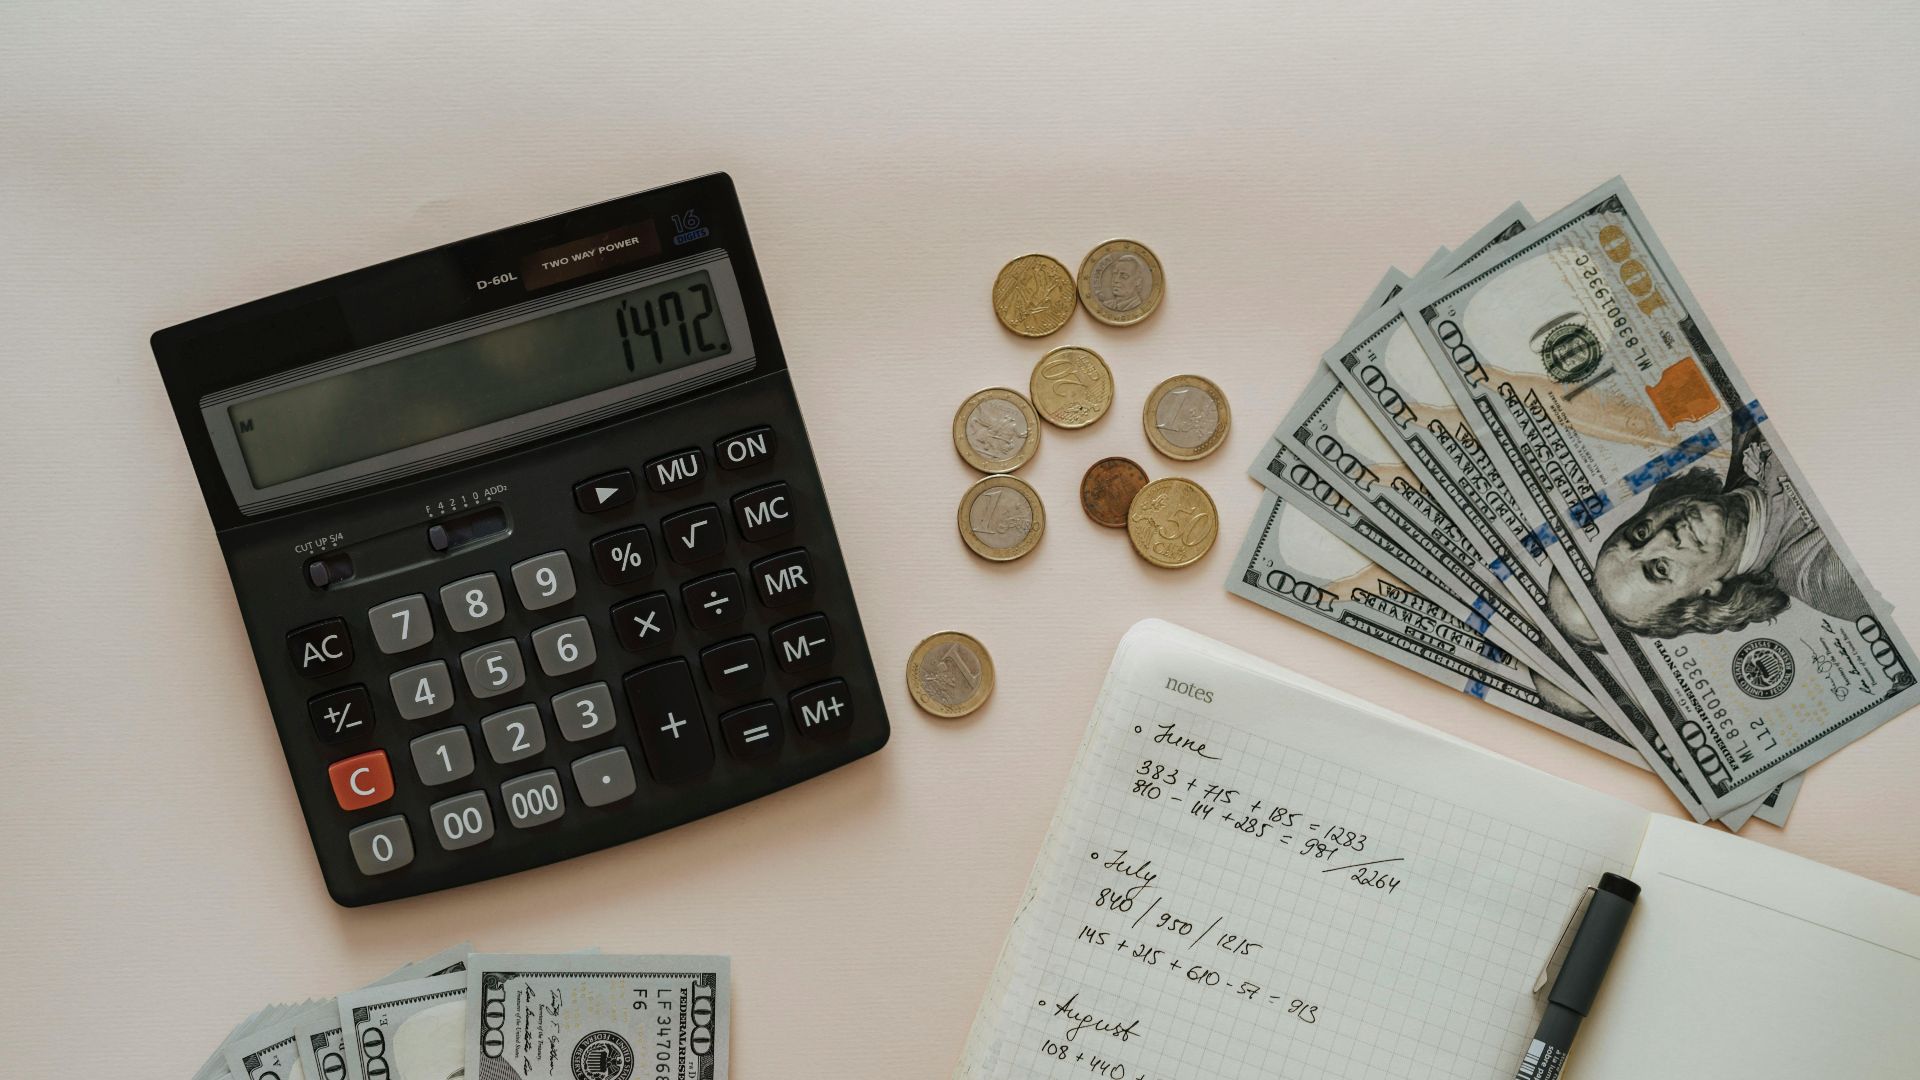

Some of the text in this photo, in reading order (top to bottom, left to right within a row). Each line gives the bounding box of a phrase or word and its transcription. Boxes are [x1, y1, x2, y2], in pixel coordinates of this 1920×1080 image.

[671, 209, 701, 234] 16
[676, 228, 707, 244] DIGITS
[541, 236, 640, 271] TWO WAY POWER
[1595, 222, 1667, 317] 100
[476, 271, 518, 291] D-60L
[1573, 252, 1653, 372] ML 83801932 C
[1435, 318, 1488, 389] 100
[1358, 363, 1418, 430] 100
[239, 419, 254, 434] M
[1495, 379, 1554, 464] STATES
[1519, 387, 1589, 490] AMERICA
[727, 434, 767, 462] ON
[1313, 431, 1380, 493] 100
[1425, 416, 1493, 496] STATES
[1519, 441, 1555, 493] THE
[656, 454, 698, 485] MU
[1408, 437, 1467, 508] DOLLARS
[425, 505, 431, 514] F
[437, 501, 444, 510] 4
[450, 498, 456, 507] 2
[462, 495, 467, 504] 1
[472, 491, 479, 500] 0
[1288, 462, 1357, 518] 100
[1388, 474, 1465, 544] STATES
[1456, 475, 1498, 524] THE
[1476, 397, 1593, 583] ONE HUNDRED DOLLARS
[1542, 457, 1602, 542] UNITED
[1576, 480, 1606, 518] OF
[1783, 483, 1810, 521] FRANKLIN
[743, 496, 789, 528] MC
[1158, 506, 1212, 548] 50
[1374, 498, 1444, 560] DOLLARS
[1482, 487, 1551, 567] UNITED
[294, 532, 344, 554] CUT UP 5/4
[611, 542, 642, 572] %
[1429, 526, 1477, 570] THE
[1462, 503, 1524, 578] HUNDRED
[535, 567, 557, 597] 9
[764, 565, 808, 595] MR
[1264, 567, 1340, 613] 100
[1440, 554, 1511, 618] HUNDRED
[1518, 573, 1548, 607] ONE
[465, 589, 488, 618] 8
[1348, 585, 1438, 635] STATES
[391, 609, 410, 640] 7
[1402, 624, 1457, 655] THE
[1507, 613, 1541, 644] ONE
[303, 634, 343, 668] AC
[557, 633, 578, 662] 6
[1341, 613, 1541, 705] ONE HUNDRED DOLLARS
[1672, 643, 1689, 659] C
[1854, 612, 1907, 683] 100
[486, 655, 508, 686] 5
[1732, 655, 1762, 699] UNITED STATES
[1772, 640, 1794, 697] FEDERAL RESERVE
[414, 677, 436, 705] 4
[1165, 677, 1214, 704] notes
[1652, 637, 1740, 772] FEDERAL RESERVE NOTE
[1680, 655, 1741, 742] 83801932
[576, 699, 599, 729] 3
[801, 696, 844, 727] M+
[506, 722, 530, 752] 2
[1153, 723, 1222, 761] June
[1731, 738, 1755, 764] ML
[1747, 715, 1778, 751] L12
[436, 745, 452, 772] 1
[1678, 717, 1732, 789] 100
[350, 767, 376, 796] C
[1136, 760, 1179, 785] 383
[1187, 778, 1198, 791] +
[1203, 784, 1240, 804] 715
[1251, 800, 1262, 812] +
[1269, 806, 1303, 827] 185
[511, 784, 558, 819] 000
[1132, 779, 1161, 799] 810
[1299, 838, 1339, 861] 981
[443, 807, 483, 840] 00
[372, 834, 393, 862] 0
[1104, 850, 1157, 901] July
[1351, 868, 1401, 894] 2264
[1095, 887, 1134, 913] 840
[1156, 912, 1193, 936] 950
[1217, 933, 1263, 955] 1215
[1078, 925, 1319, 1024] 145 + 215 + 610 57 913
[632, 988, 647, 1010] F6
[656, 988, 672, 1010] LF
[678, 987, 687, 1045] FEDERAL
[690, 979, 712, 1056] 100
[1054, 993, 1141, 1042] August
[482, 982, 506, 1059] 100
[573, 1033, 610, 1079] FEDERAL RESERVE
[613, 1037, 631, 1063] UNITED
[1041, 1039, 1125, 1080] 108 + 440
[1540, 1044, 1555, 1068] sobre
